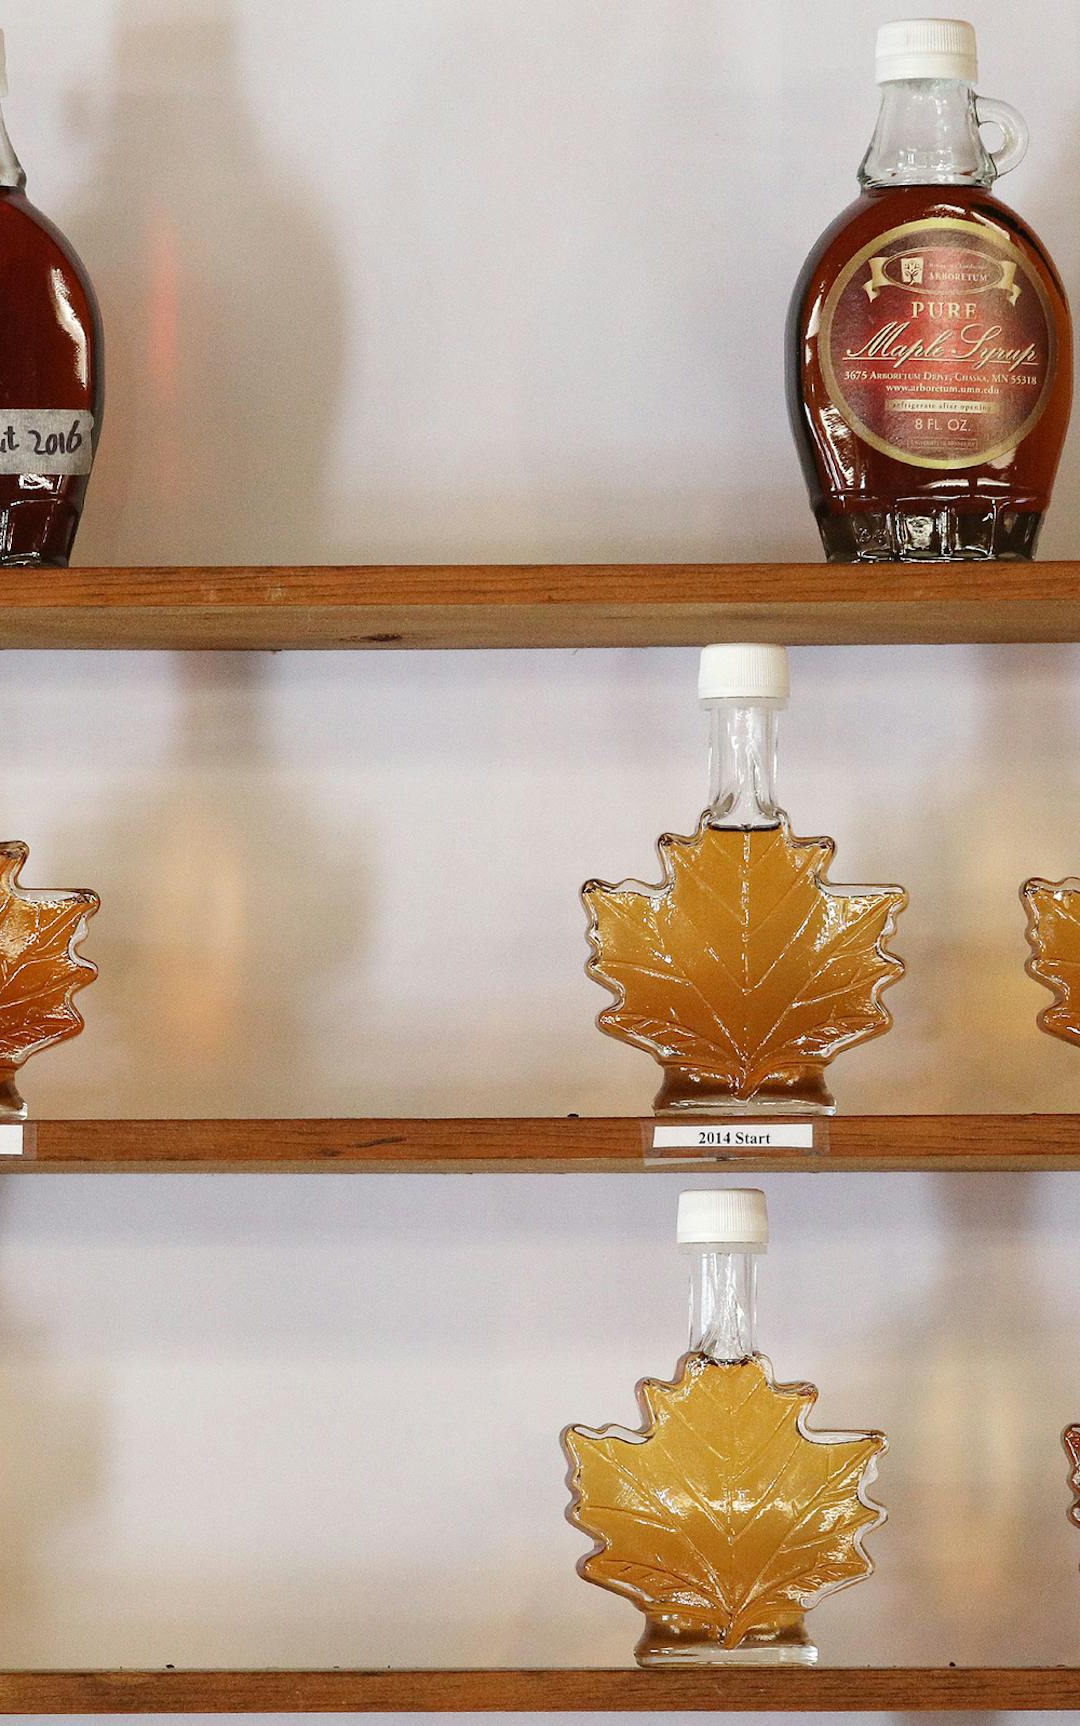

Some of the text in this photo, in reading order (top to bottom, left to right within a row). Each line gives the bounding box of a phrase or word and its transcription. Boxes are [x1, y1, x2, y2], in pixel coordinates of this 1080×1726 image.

[911, 301, 977, 320] PURE
[846, 321, 1038, 372] Maple Syrup
[844, 370, 868, 381] 3675
[991, 374, 1009, 384] MN
[1010, 375, 1038, 386] 55318
[885, 383, 1000, 395] www.arboretum.umn.edu
[915, 419, 923, 430] 8
[947, 419, 971, 431] OZ.
[27, 419, 83, 455] 2016
[698, 1132, 771, 1144] 2014 Start
